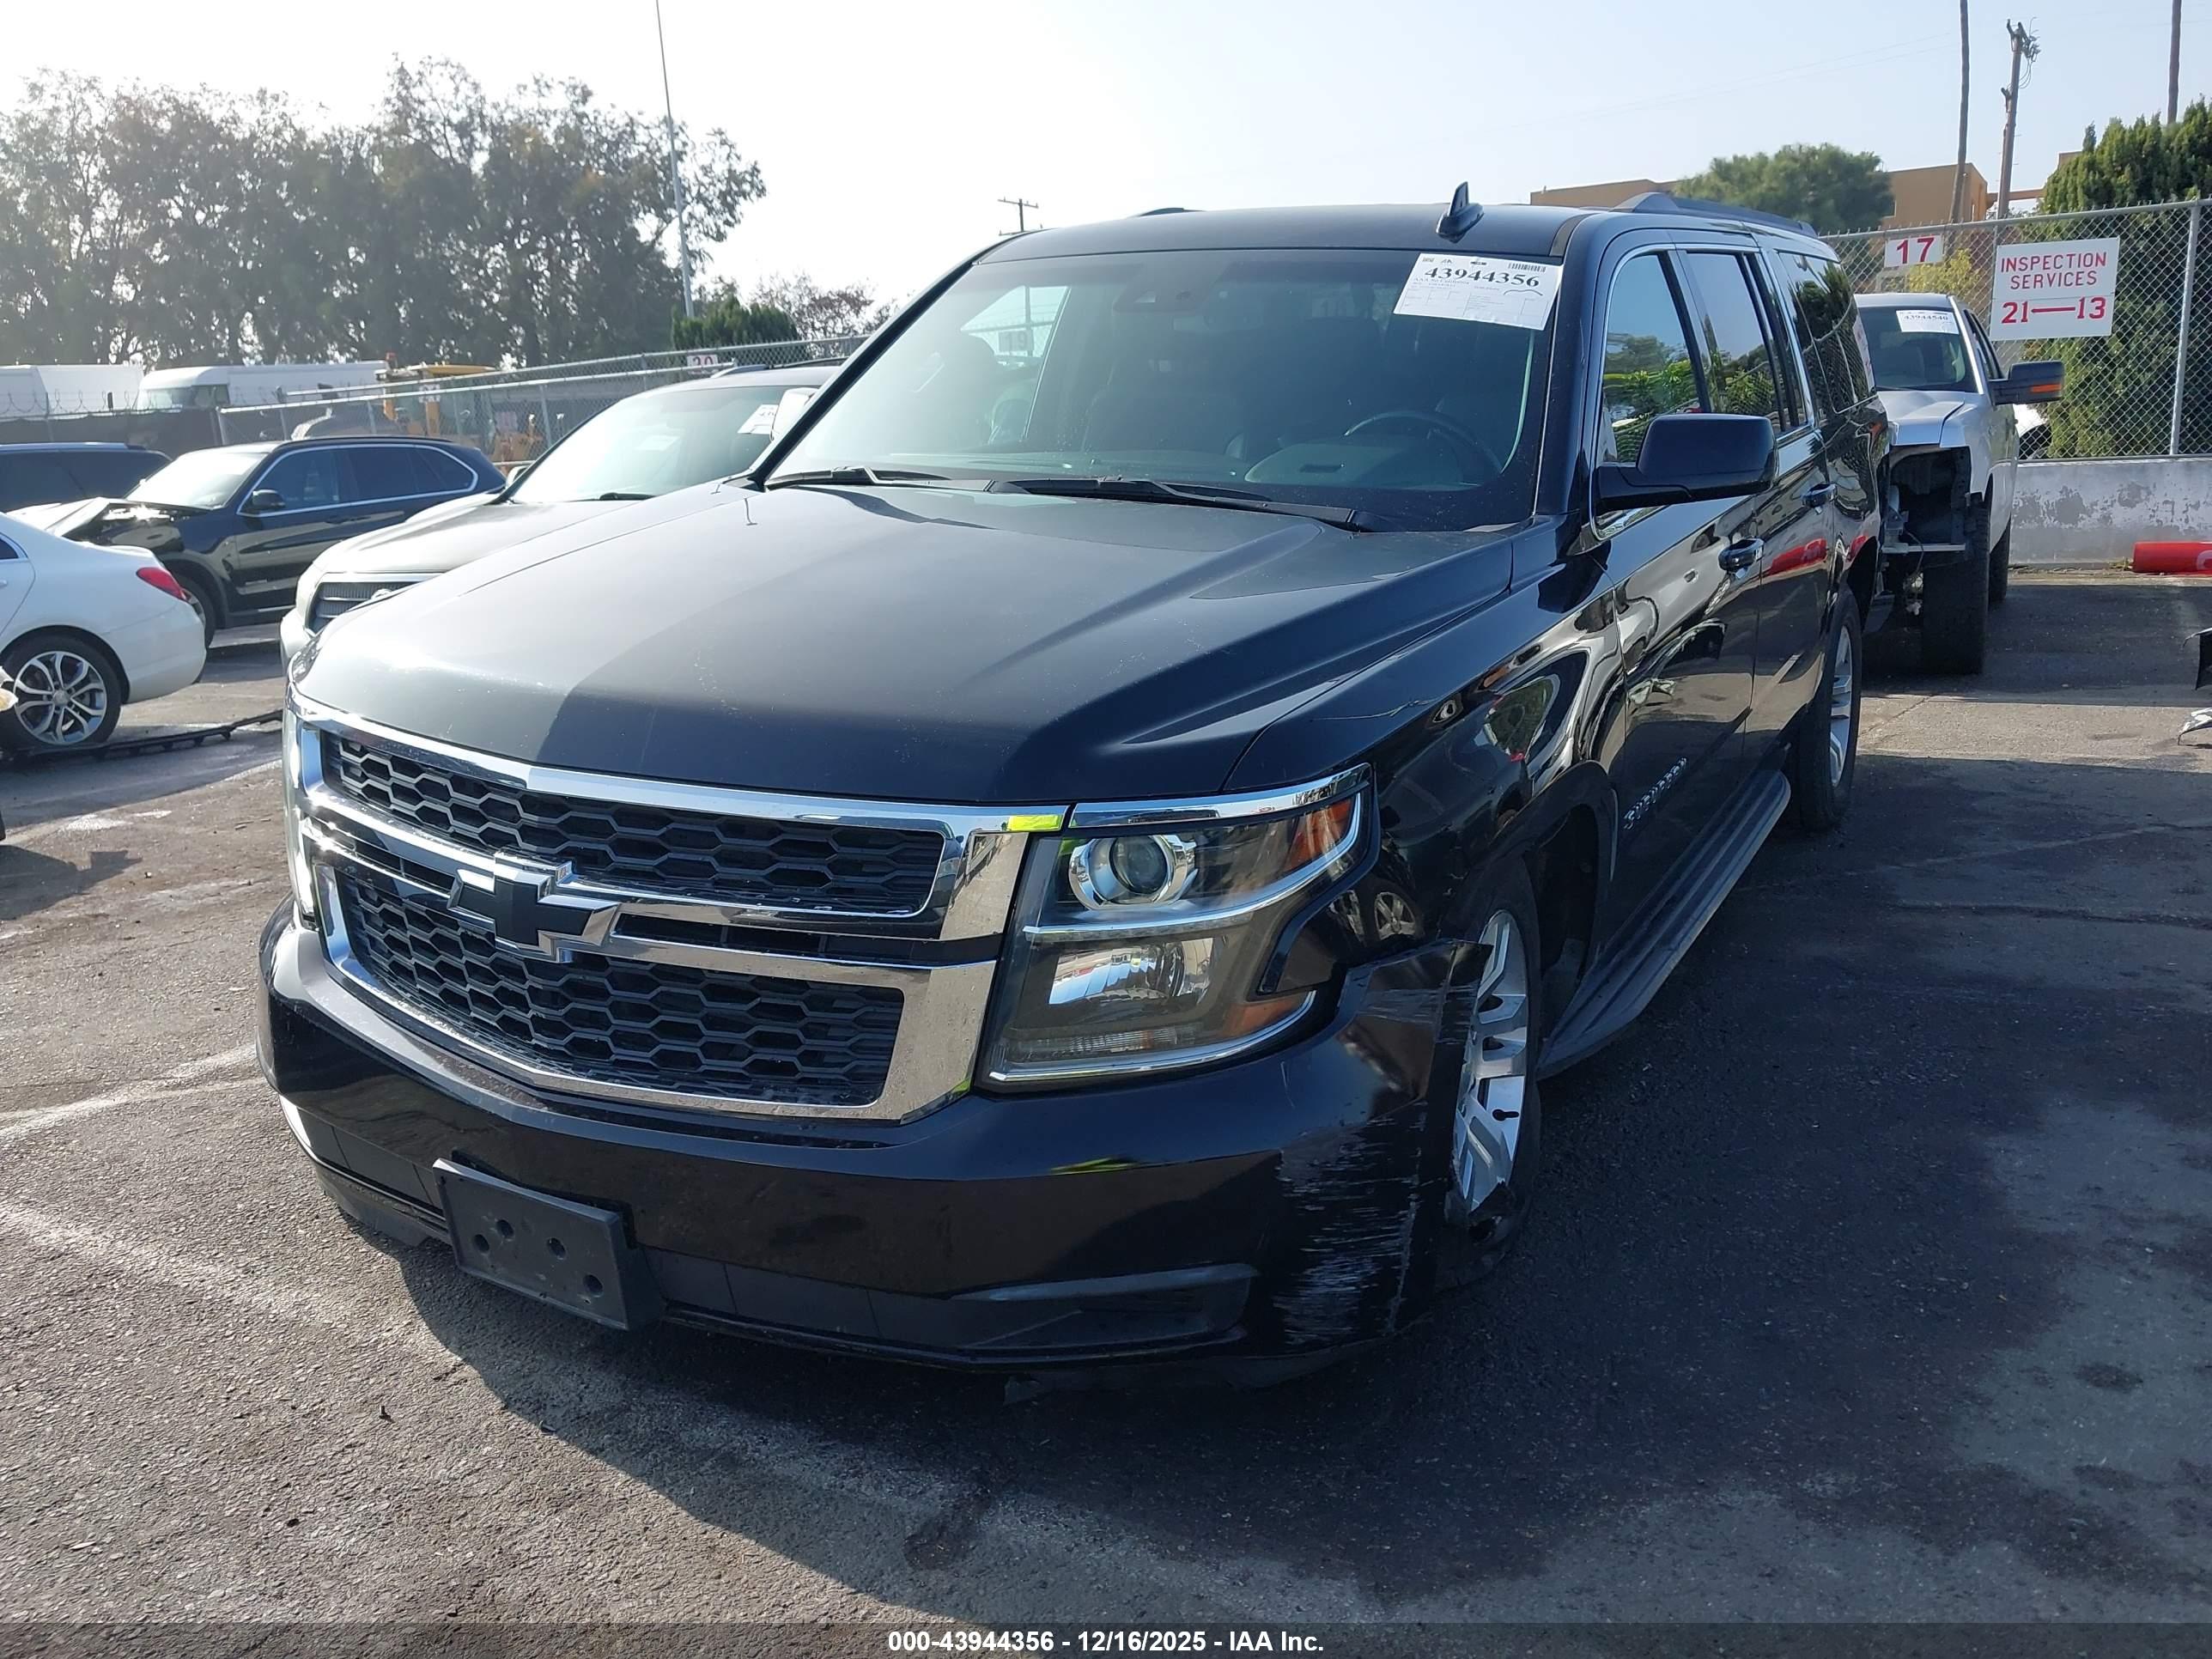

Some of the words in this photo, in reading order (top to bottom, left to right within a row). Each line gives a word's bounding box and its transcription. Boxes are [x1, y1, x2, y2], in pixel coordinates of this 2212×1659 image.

[1895, 237, 1936, 264] 17
[2001, 252, 2107, 272] INSPECTION
[1424, 266, 1540, 288] 43944356
[2009, 270, 2098, 289] SERVICES
